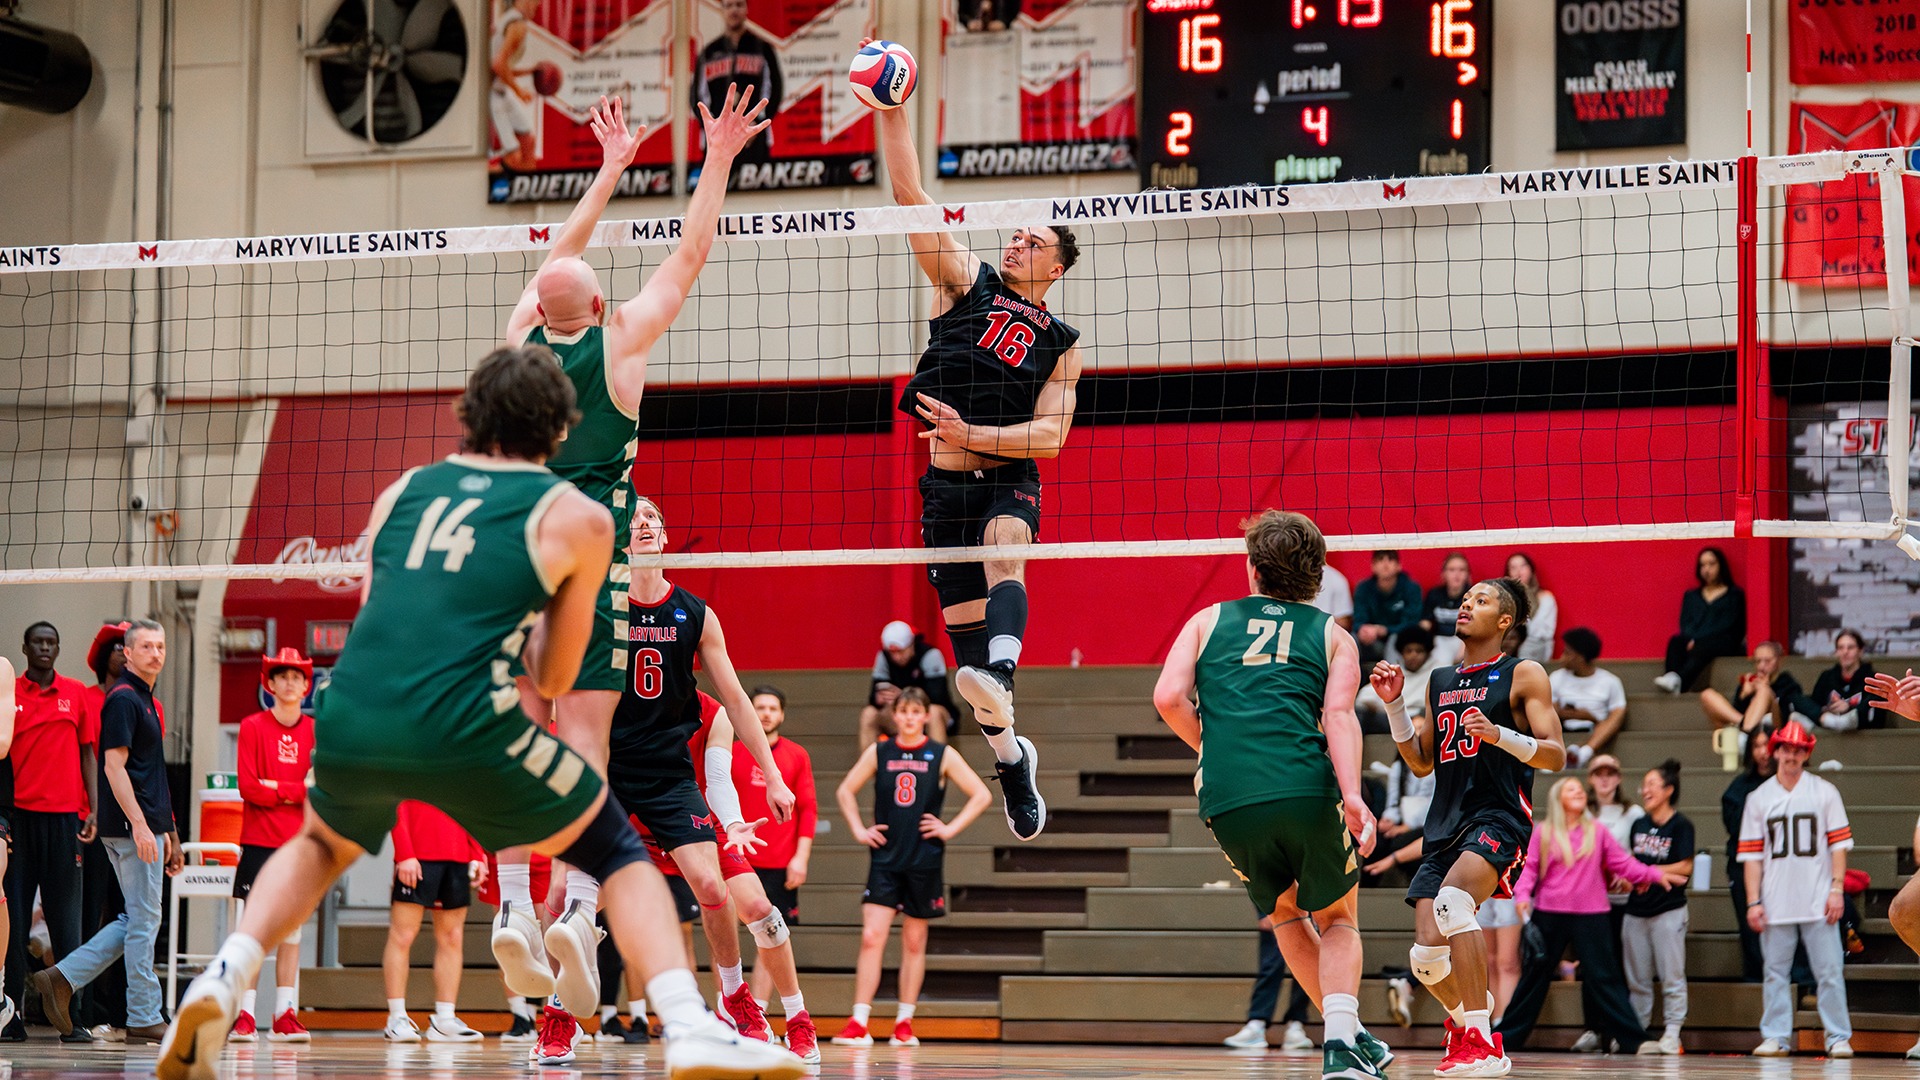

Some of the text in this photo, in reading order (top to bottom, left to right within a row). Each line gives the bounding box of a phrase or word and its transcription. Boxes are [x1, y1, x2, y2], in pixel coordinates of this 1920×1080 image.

[1178, 13, 1222, 73] 16
[1430, 0, 1476, 58] 16
[1820, 45, 1868, 65] Men's
[891, 67, 907, 93] NCAA
[1277, 62, 1342, 96] period
[1166, 112, 1192, 156] 2
[1302, 106, 1329, 146] 4
[1451, 98, 1463, 140] 1
[738, 162, 826, 190] BAKER
[959, 145, 1108, 175] RODRIGUEZ
[1275, 154, 1342, 184] player
[510, 170, 653, 203] DUETHAN
[1501, 160, 1738, 195] MARYVILLE SAINT
[1052, 187, 1290, 220] MARYVILLE SAINTS
[632, 211, 856, 240] MARILLE SAINTS
[0, 248, 61, 267] AINTS
[236, 230, 447, 259] MARYVILLE SAINTS
[993, 294, 1052, 331] MARYVILLE
[977, 311, 1036, 368] 16
[405, 496, 483, 572] 14
[629, 626, 677, 642] ARYVILLE
[1242, 618, 1294, 666] 21
[634, 647, 663, 700] 6
[1438, 687, 1488, 707] MARYVILLE
[894, 772, 917, 807] 8
[1766, 812, 1818, 859] 00
[184, 875, 231, 885] GATORADE
